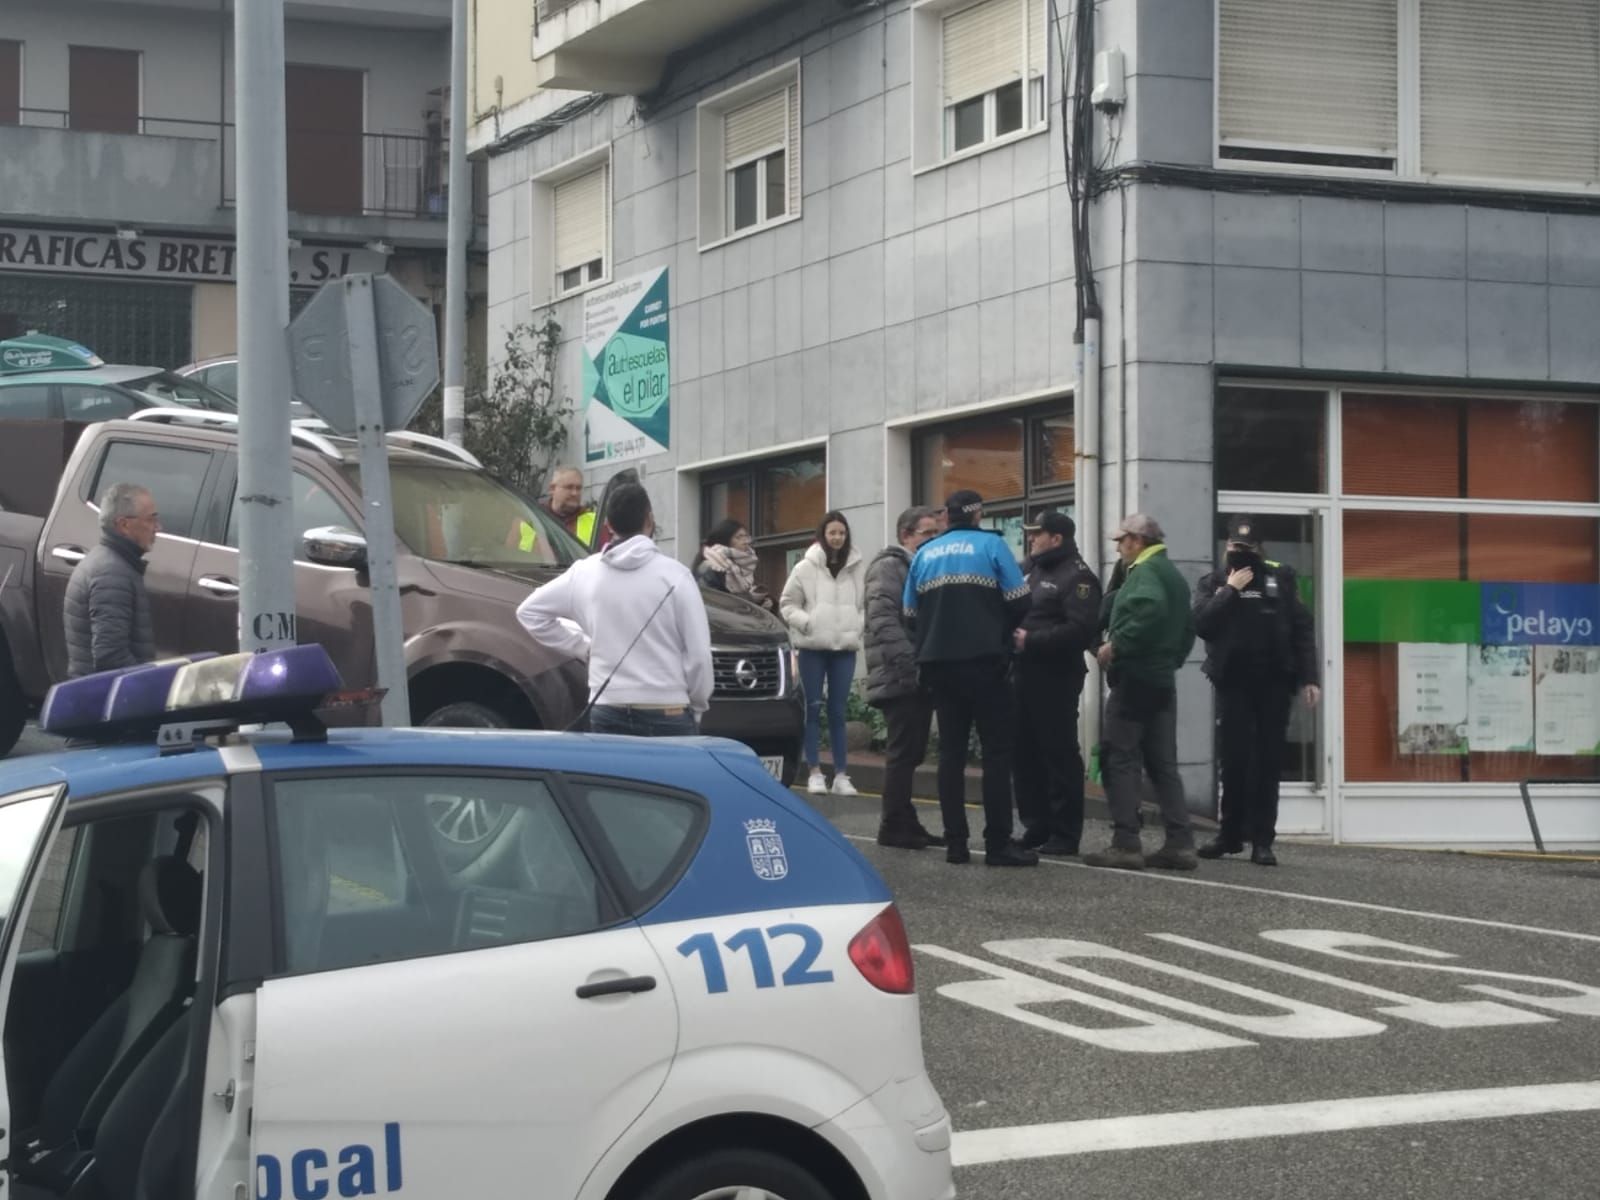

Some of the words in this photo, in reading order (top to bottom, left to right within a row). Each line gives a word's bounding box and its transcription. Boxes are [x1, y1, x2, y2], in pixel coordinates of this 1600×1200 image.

[0, 232, 146, 270] RAFICAS
[623, 375, 634, 404] el
[638, 370, 666, 409] pilar
[253, 612, 295, 640] CM
[1507, 610, 1592, 643] pelayo
[676, 922, 835, 994] 112
[256, 1121, 402, 1200] ocal
